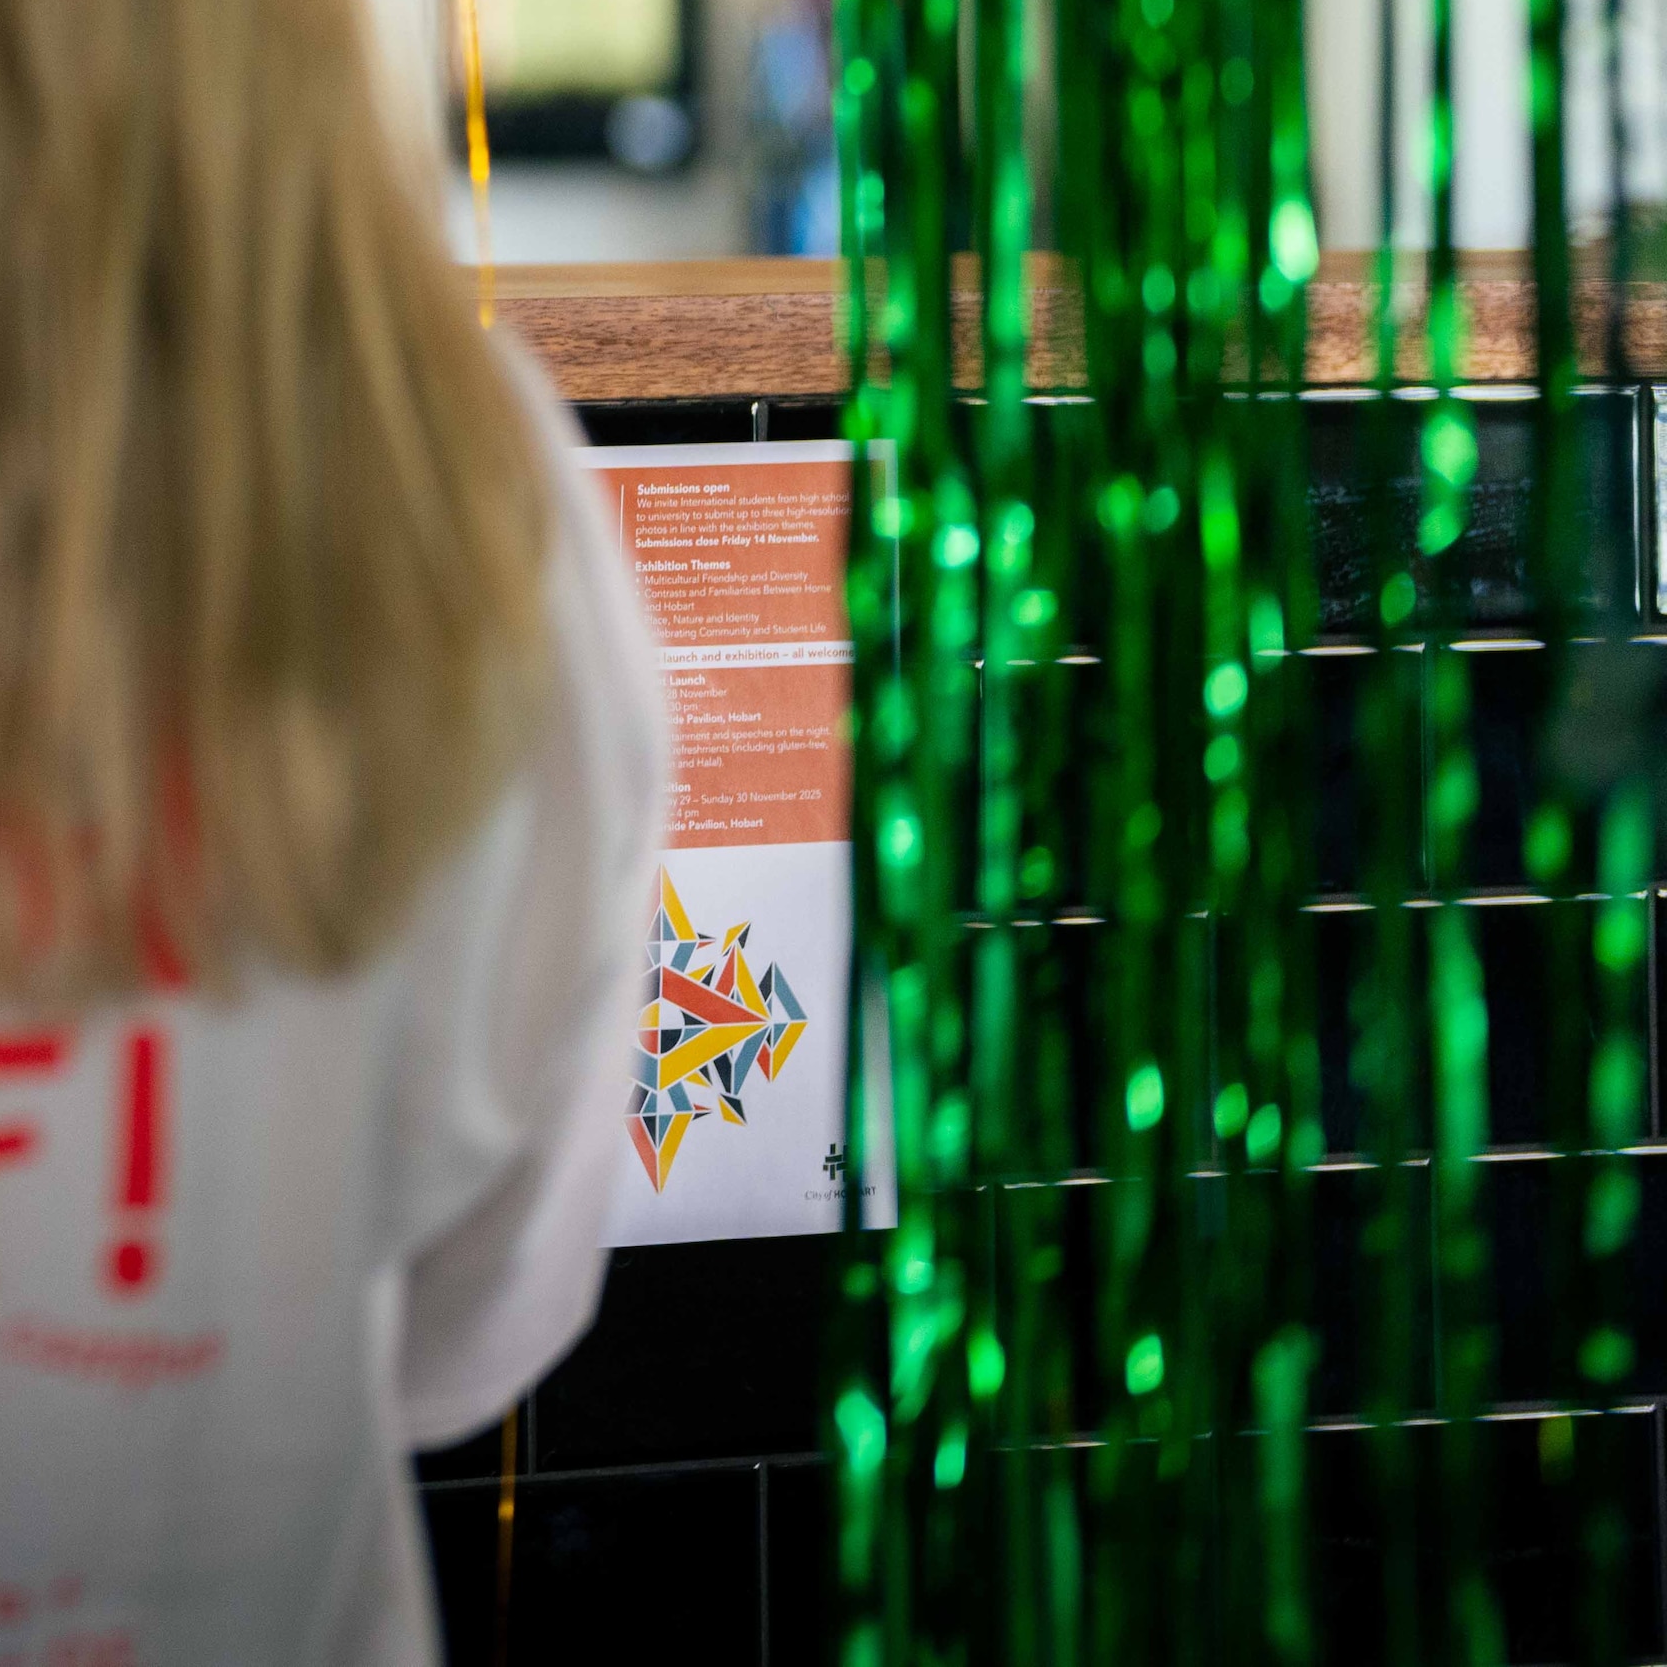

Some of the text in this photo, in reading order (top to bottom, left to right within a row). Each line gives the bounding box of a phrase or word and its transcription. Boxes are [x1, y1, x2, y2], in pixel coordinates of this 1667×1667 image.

[637, 483, 730, 495] Submissions open
[637, 491, 850, 508] We invite International students from high school
[636, 513, 646, 522] to
[648, 512, 690, 522] university
[693, 511, 702, 520] to
[705, 509, 734, 519] submit
[737, 510, 748, 520] up
[751, 509, 760, 518] to
[763, 507, 785, 517] three
[635, 524, 667, 537] photos
[670, 525, 678, 533] in
[680, 523, 696, 533] line
[699, 523, 717, 532] with
[720, 522, 734, 532] the
[736, 521, 779, 532] exhibition
[635, 532, 819, 548] Submissions close Friday 14 November.
[635, 559, 731, 572] Exhibition Themes
[644, 570, 808, 585] Multicultural Friendship and Diversity
[644, 583, 832, 598] Contrasts and Familiarities Between Home
[664, 601, 695, 611] Hobart
[673, 614, 704, 624] Nature
[706, 613, 723, 623] and
[726, 612, 759, 624] Identity
[653, 623, 827, 640] lebrating Community and Student Life
[663, 651, 698, 663] launch
[701, 650, 721, 662] and
[725, 648, 780, 661] exhibition
[792, 647, 804, 659] all
[808, 646, 854, 658] welcome
[669, 674, 706, 686] Launch
[679, 687, 728, 698] November
[683, 703, 698, 713] pm
[687, 713, 726, 725] Pavilion,
[728, 712, 762, 723] Hobart
[672, 731, 710, 742] tainment
[713, 729, 730, 740] and
[732, 728, 773, 741] speeches
[775, 729, 787, 737] on
[789, 726, 804, 737] the
[672, 743, 729, 755] refreshments
[731, 741, 774, 753] (including
[678, 758, 695, 768] and
[666, 781, 691, 792] ition
[680, 795, 691, 805] 29
[701, 793, 734, 805] Sunday
[736, 792, 748, 803] 30
[750, 789, 797, 802] November
[799, 789, 822, 800] 2025
[684, 809, 700, 820] pm
[688, 819, 728, 830] Pavilion,
[730, 818, 764, 828] Hobart
[805, 1186, 876, 1201] City of HOART
